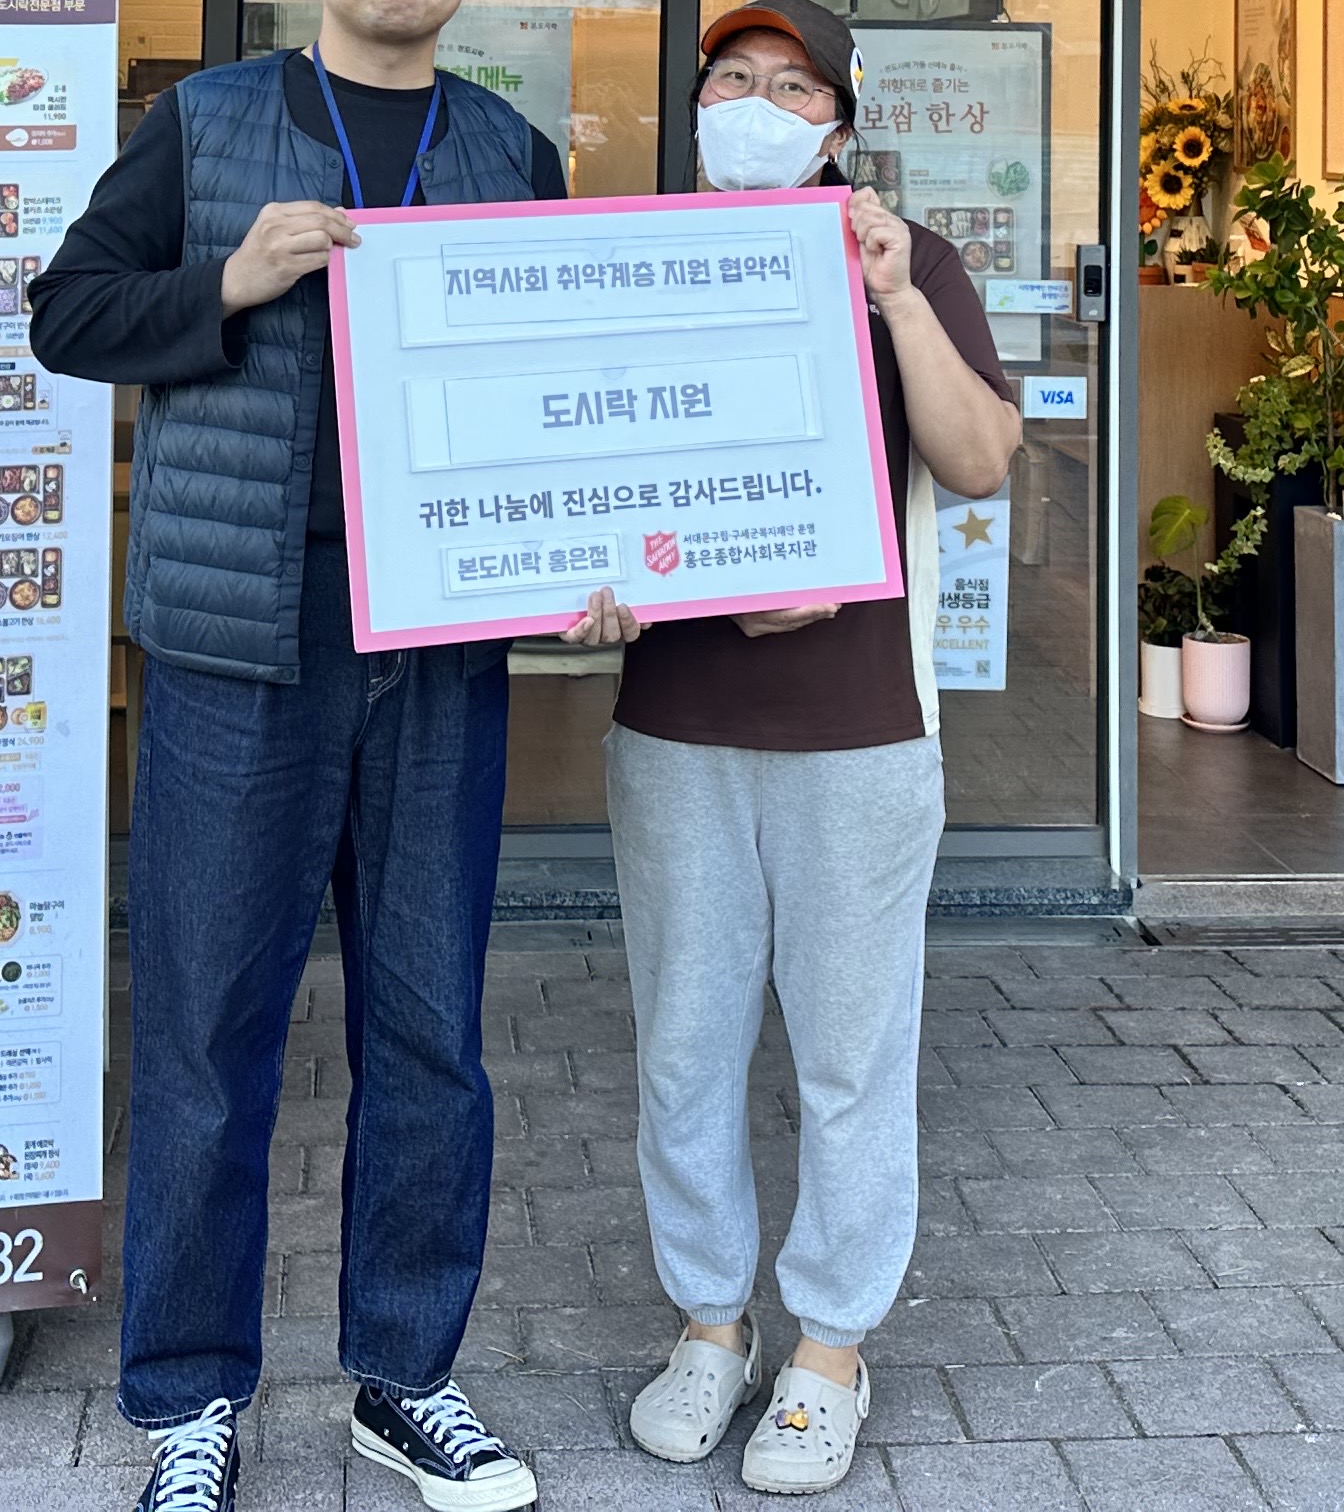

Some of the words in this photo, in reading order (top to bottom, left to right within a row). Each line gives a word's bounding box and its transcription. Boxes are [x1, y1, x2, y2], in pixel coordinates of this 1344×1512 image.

[477, 65, 524, 93] 메뉴
[878, 78, 928, 94] 취향대로
[931, 77, 970, 94] 즐기는
[859, 101, 918, 134] 보쌈
[446, 264, 549, 297] 지역사회
[556, 258, 656, 292] 취약계층
[661, 256, 712, 287] 지원
[717, 252, 792, 285] 협약식
[541, 388, 639, 430] 도시락
[646, 382, 713, 422] 지원
[1039, 390, 1075, 405] VISA
[418, 496, 470, 530] 귀한
[478, 491, 555, 525] 나눔에
[561, 481, 663, 518] 진심으로
[668, 468, 824, 510] 감사드립니다.
[797, 522, 816, 535] 운영
[649, 535, 664, 551] THE
[456, 549, 542, 583] 본도시락
[548, 543, 610, 573] 홍은점
[658, 551, 677, 572] ARMY
[683, 538, 818, 570] 홍은종합사회복지관
[954, 578, 990, 592] 음식점
[955, 614, 991, 635] 우수
[932, 638, 990, 650] XCELLENT
